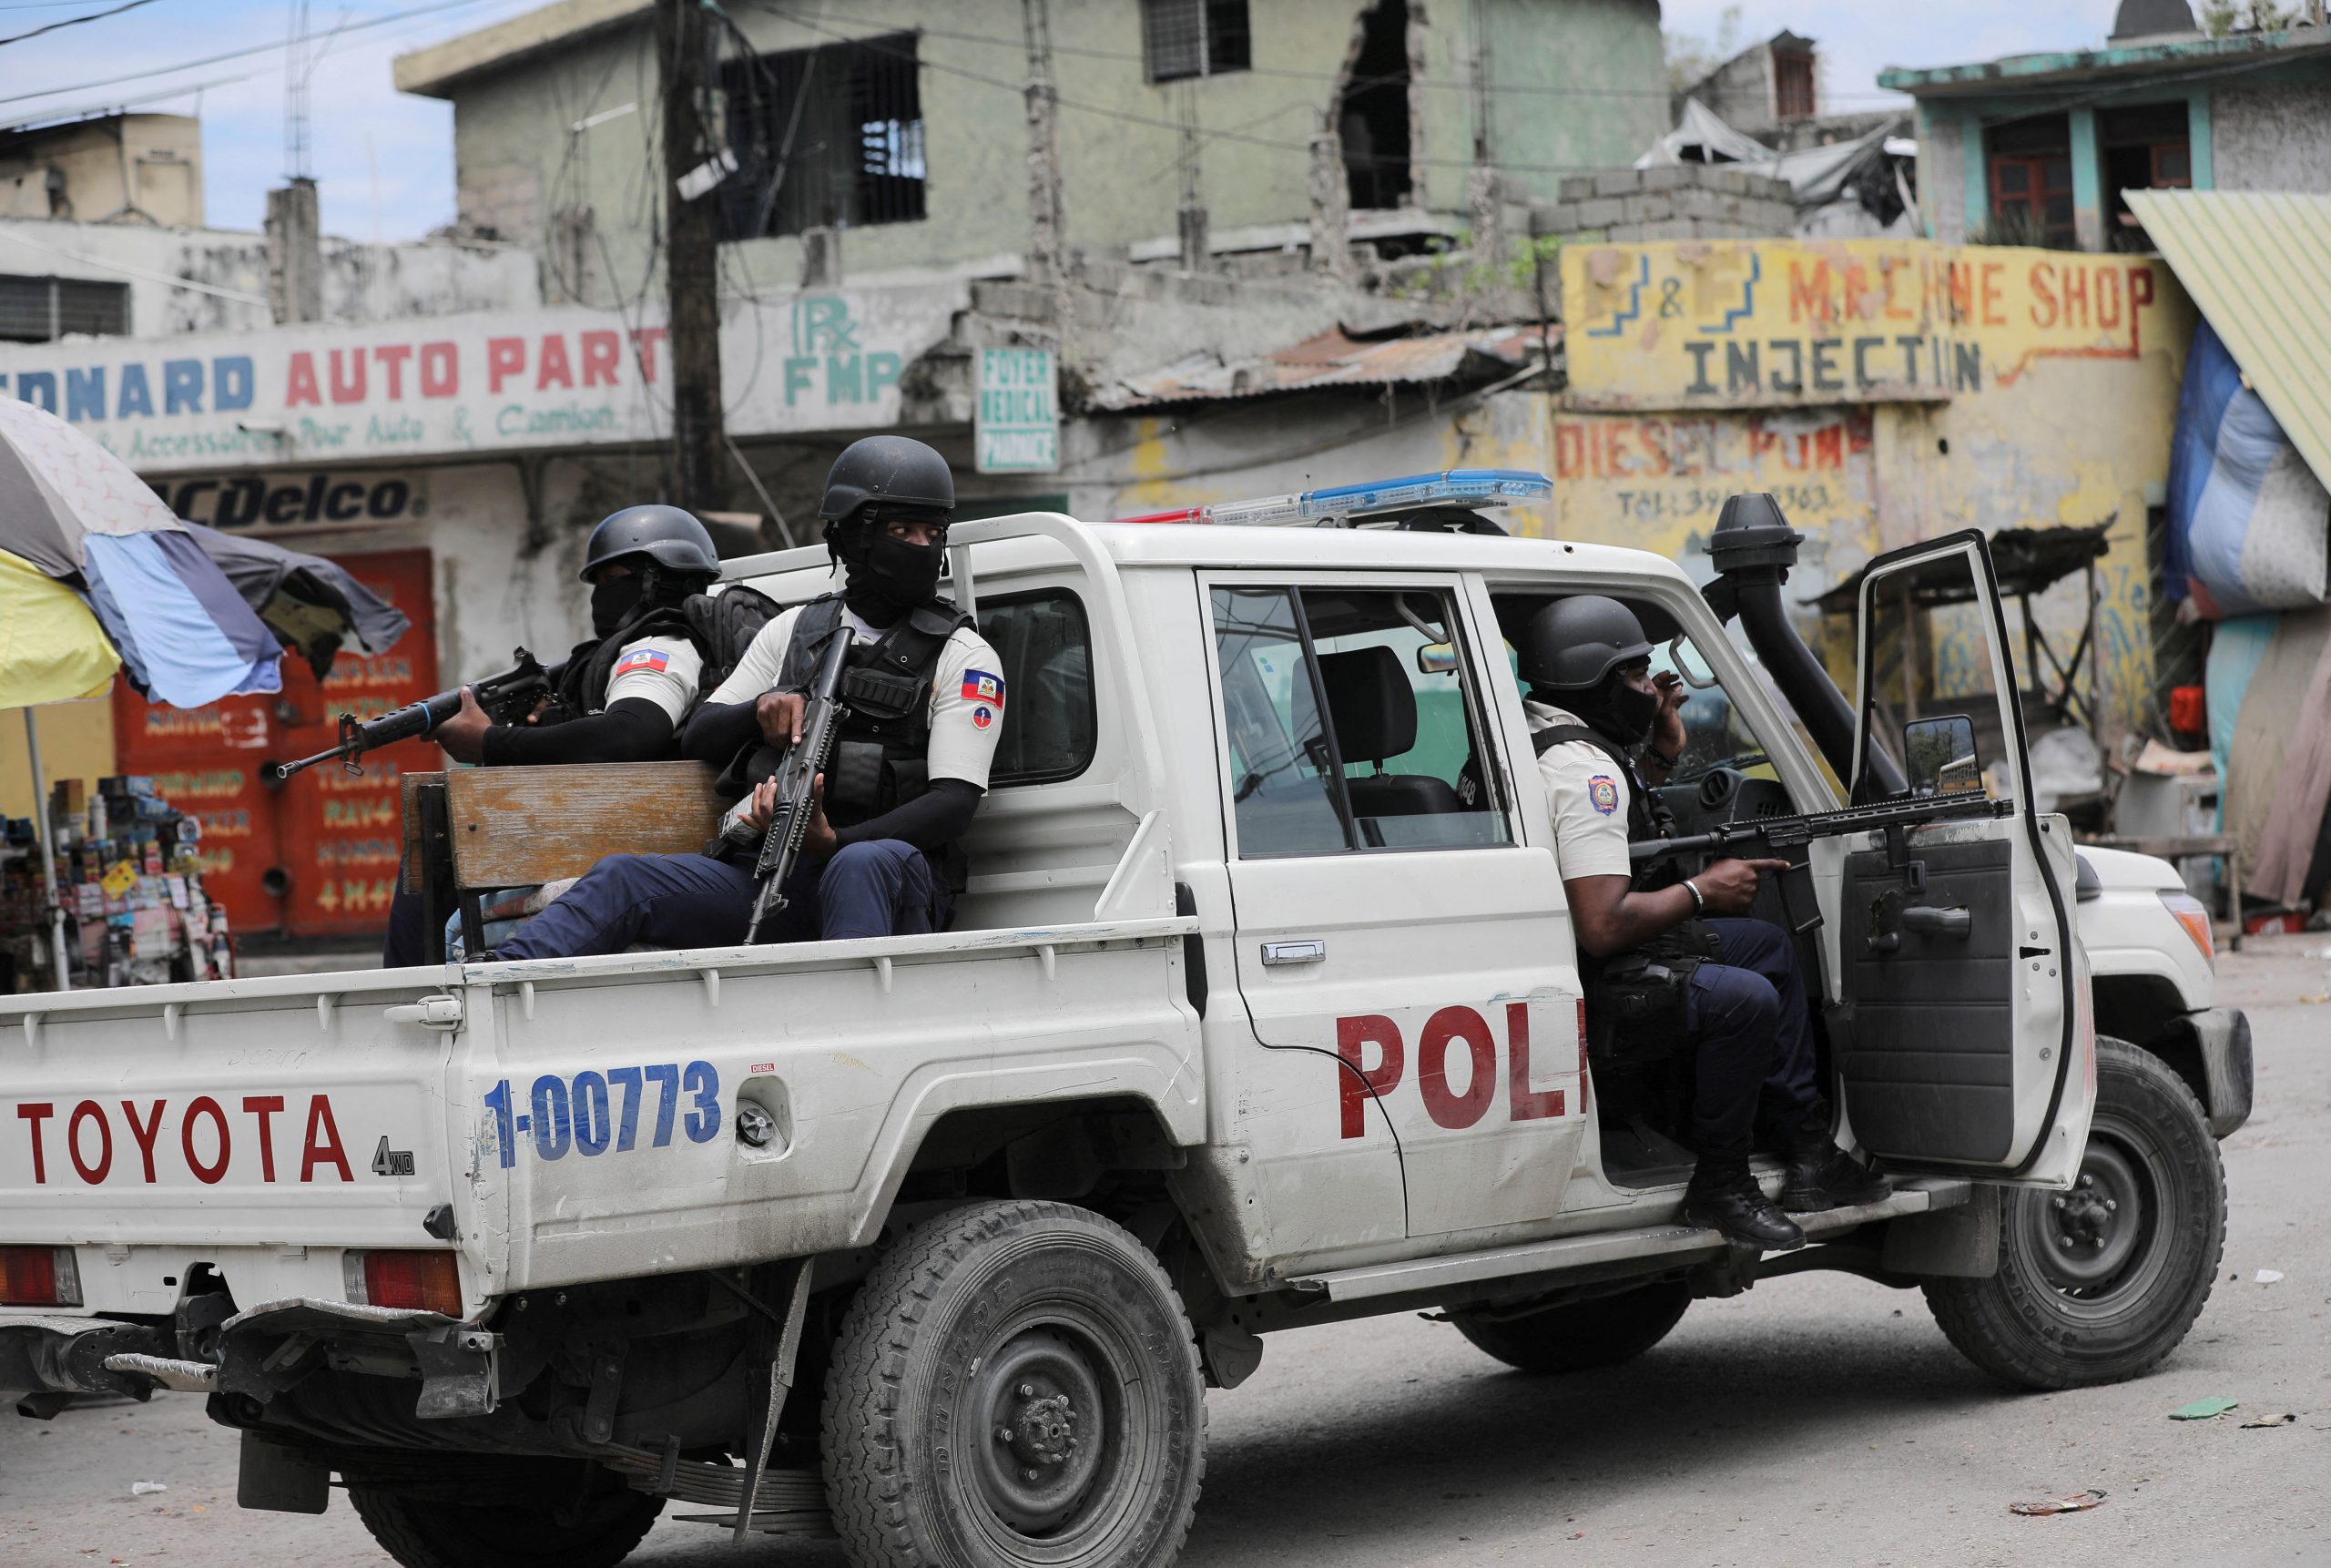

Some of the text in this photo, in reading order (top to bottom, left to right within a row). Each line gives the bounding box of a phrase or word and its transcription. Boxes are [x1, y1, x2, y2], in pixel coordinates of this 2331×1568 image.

[2029, 261, 2154, 333] SHOP
[285, 341, 459, 409] AUTO
[784, 351, 901, 407] FMP
[365, 413, 424, 444] Auto
[752, 1064, 774, 1073] DIESEL
[17, 1094, 355, 1186] TOYOTA
[484, 1060, 722, 1170] 1-00773
[372, 1135, 415, 1176] 4WD
